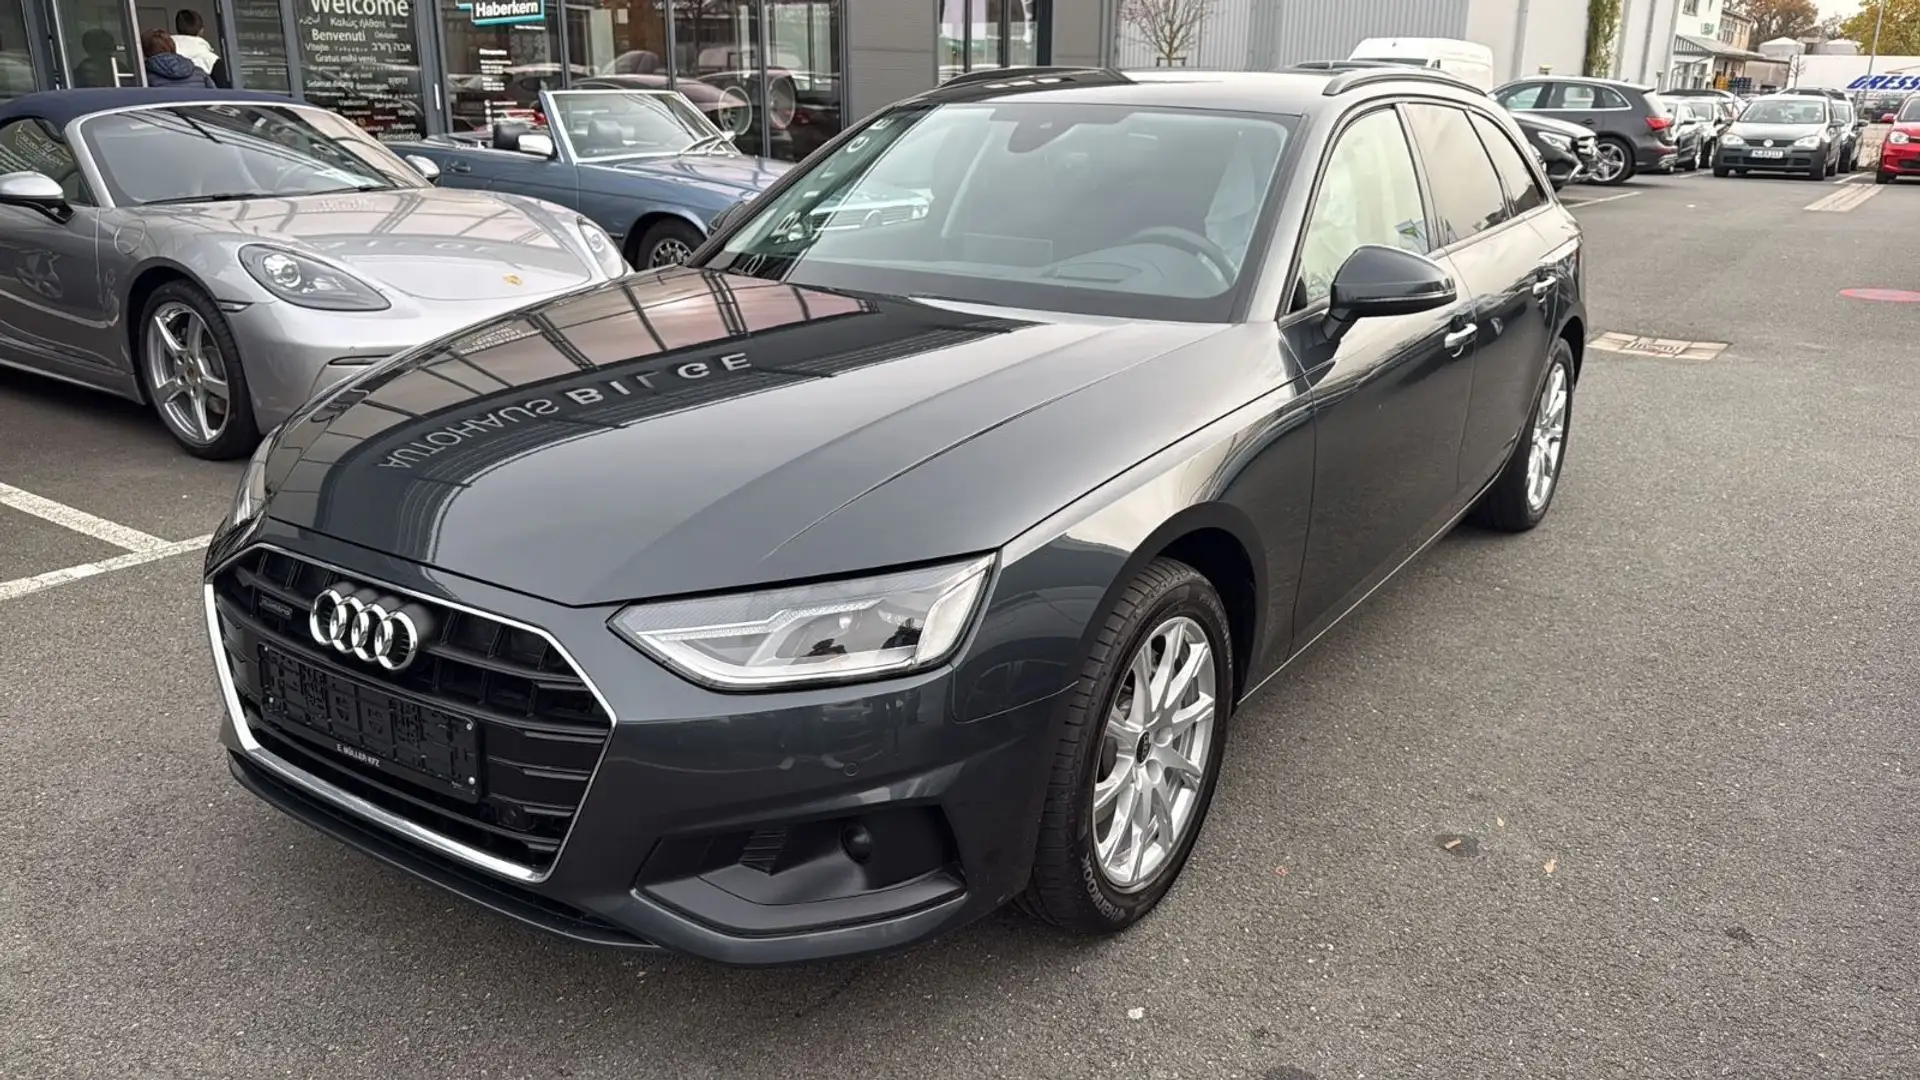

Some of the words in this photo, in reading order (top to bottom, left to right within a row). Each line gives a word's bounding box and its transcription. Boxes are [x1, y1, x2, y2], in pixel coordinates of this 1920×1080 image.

[311, 0, 409, 17] Welcome
[475, 0, 539, 17] Haberkern
[311, 28, 366, 42] Benvenuti
[1081, 851, 1119, 920] Hankook
